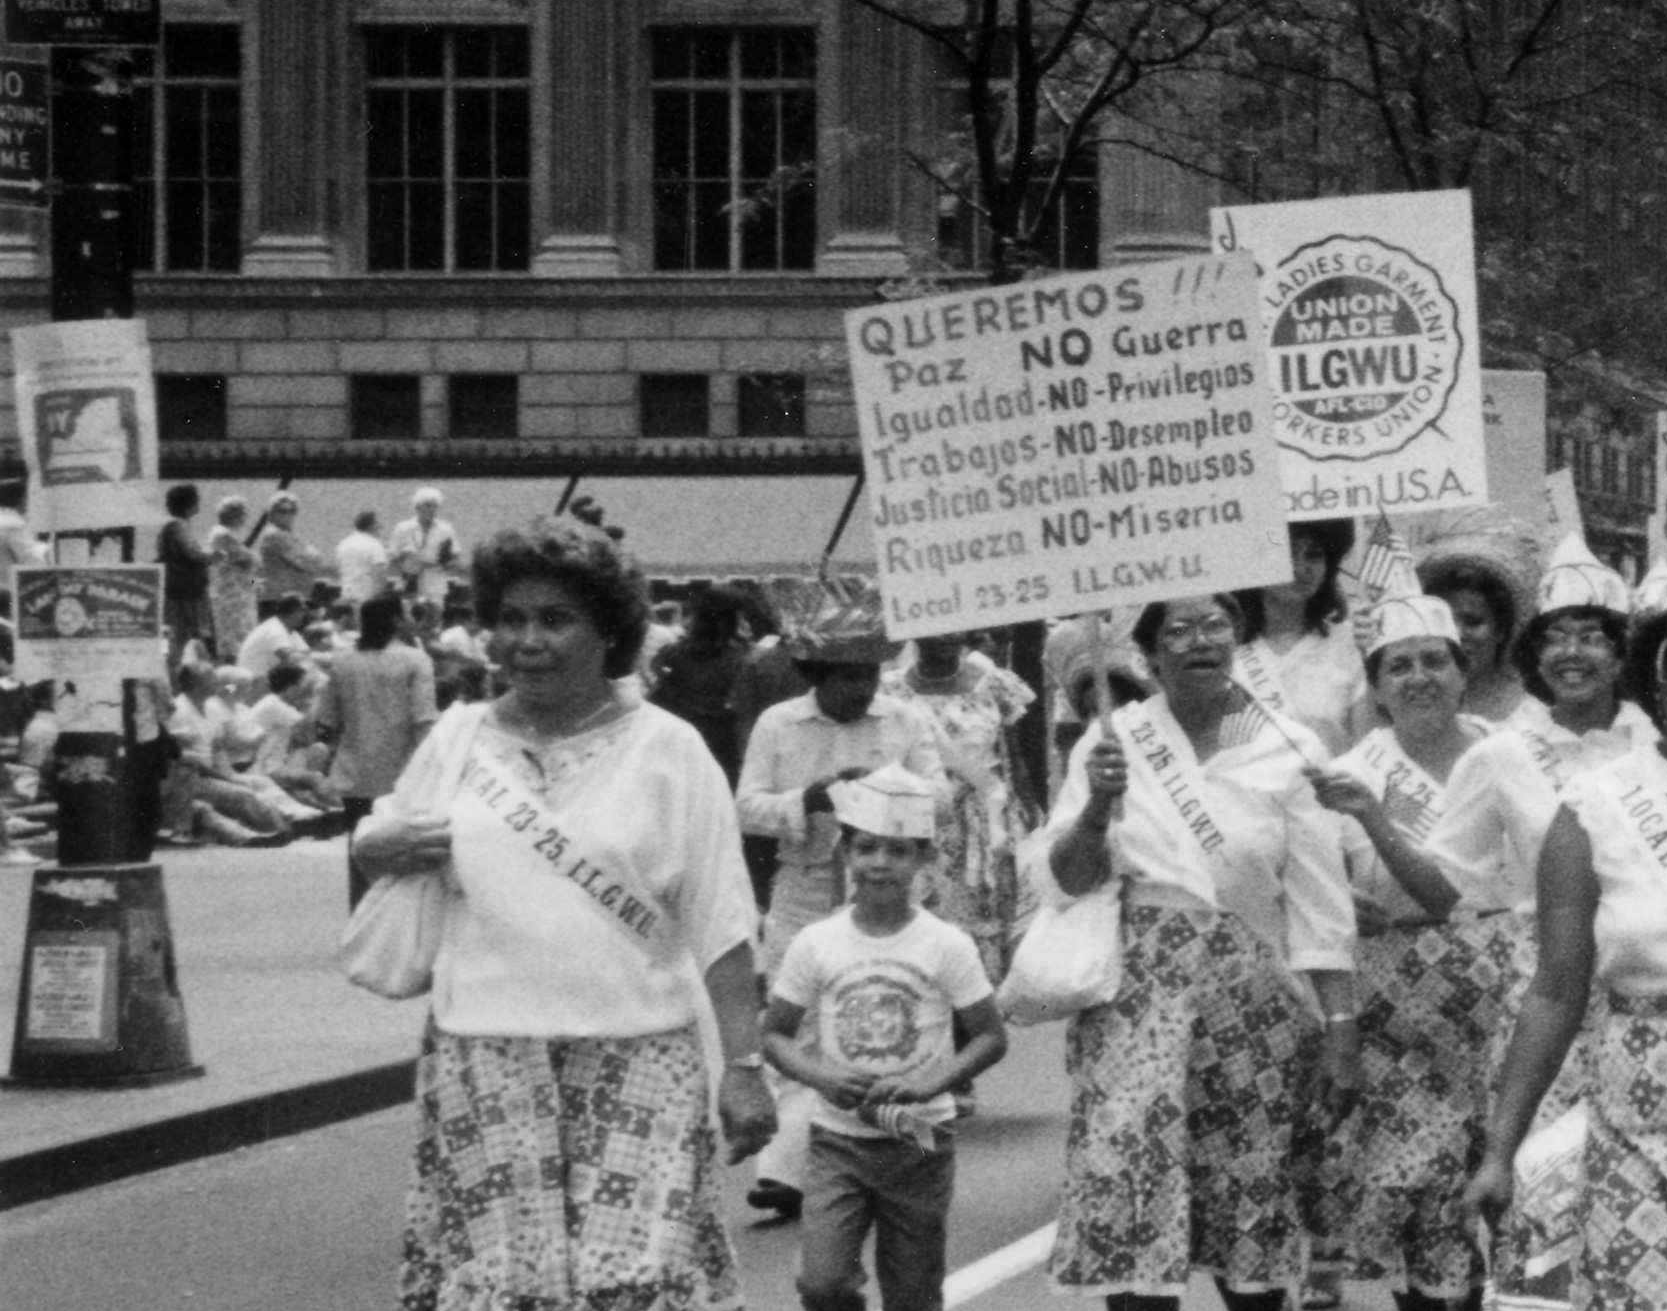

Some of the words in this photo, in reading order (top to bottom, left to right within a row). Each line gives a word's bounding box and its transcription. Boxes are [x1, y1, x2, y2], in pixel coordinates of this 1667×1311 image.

[0, 71, 23, 97] O
[0, 149, 31, 170] ME
[859, 277, 1146, 358] QUEREMOS
[1264, 251, 1346, 311] LADIES
[1354, 253, 1449, 345] GARMENT
[1289, 292, 1400, 322] UNION
[1296, 315, 1397, 343] MADE
[885, 356, 968, 394] Paz
[1019, 326, 1094, 372] NO
[1110, 316, 1249, 358] Guerra
[1280, 343, 1419, 394] ILGWU
[1272, 397, 1367, 447] ORKERS
[1373, 363, 1444, 439] UNION
[1314, 394, 1388, 416] AFL-CIO
[874, 485, 992, 530] Justicia
[1347, 473, 1373, 506] in
[1377, 465, 1474, 506] U.S.A.
[885, 528, 1027, 579] Riqueza
[891, 585, 962, 624] Local
[975, 574, 1050, 612] 23-25
